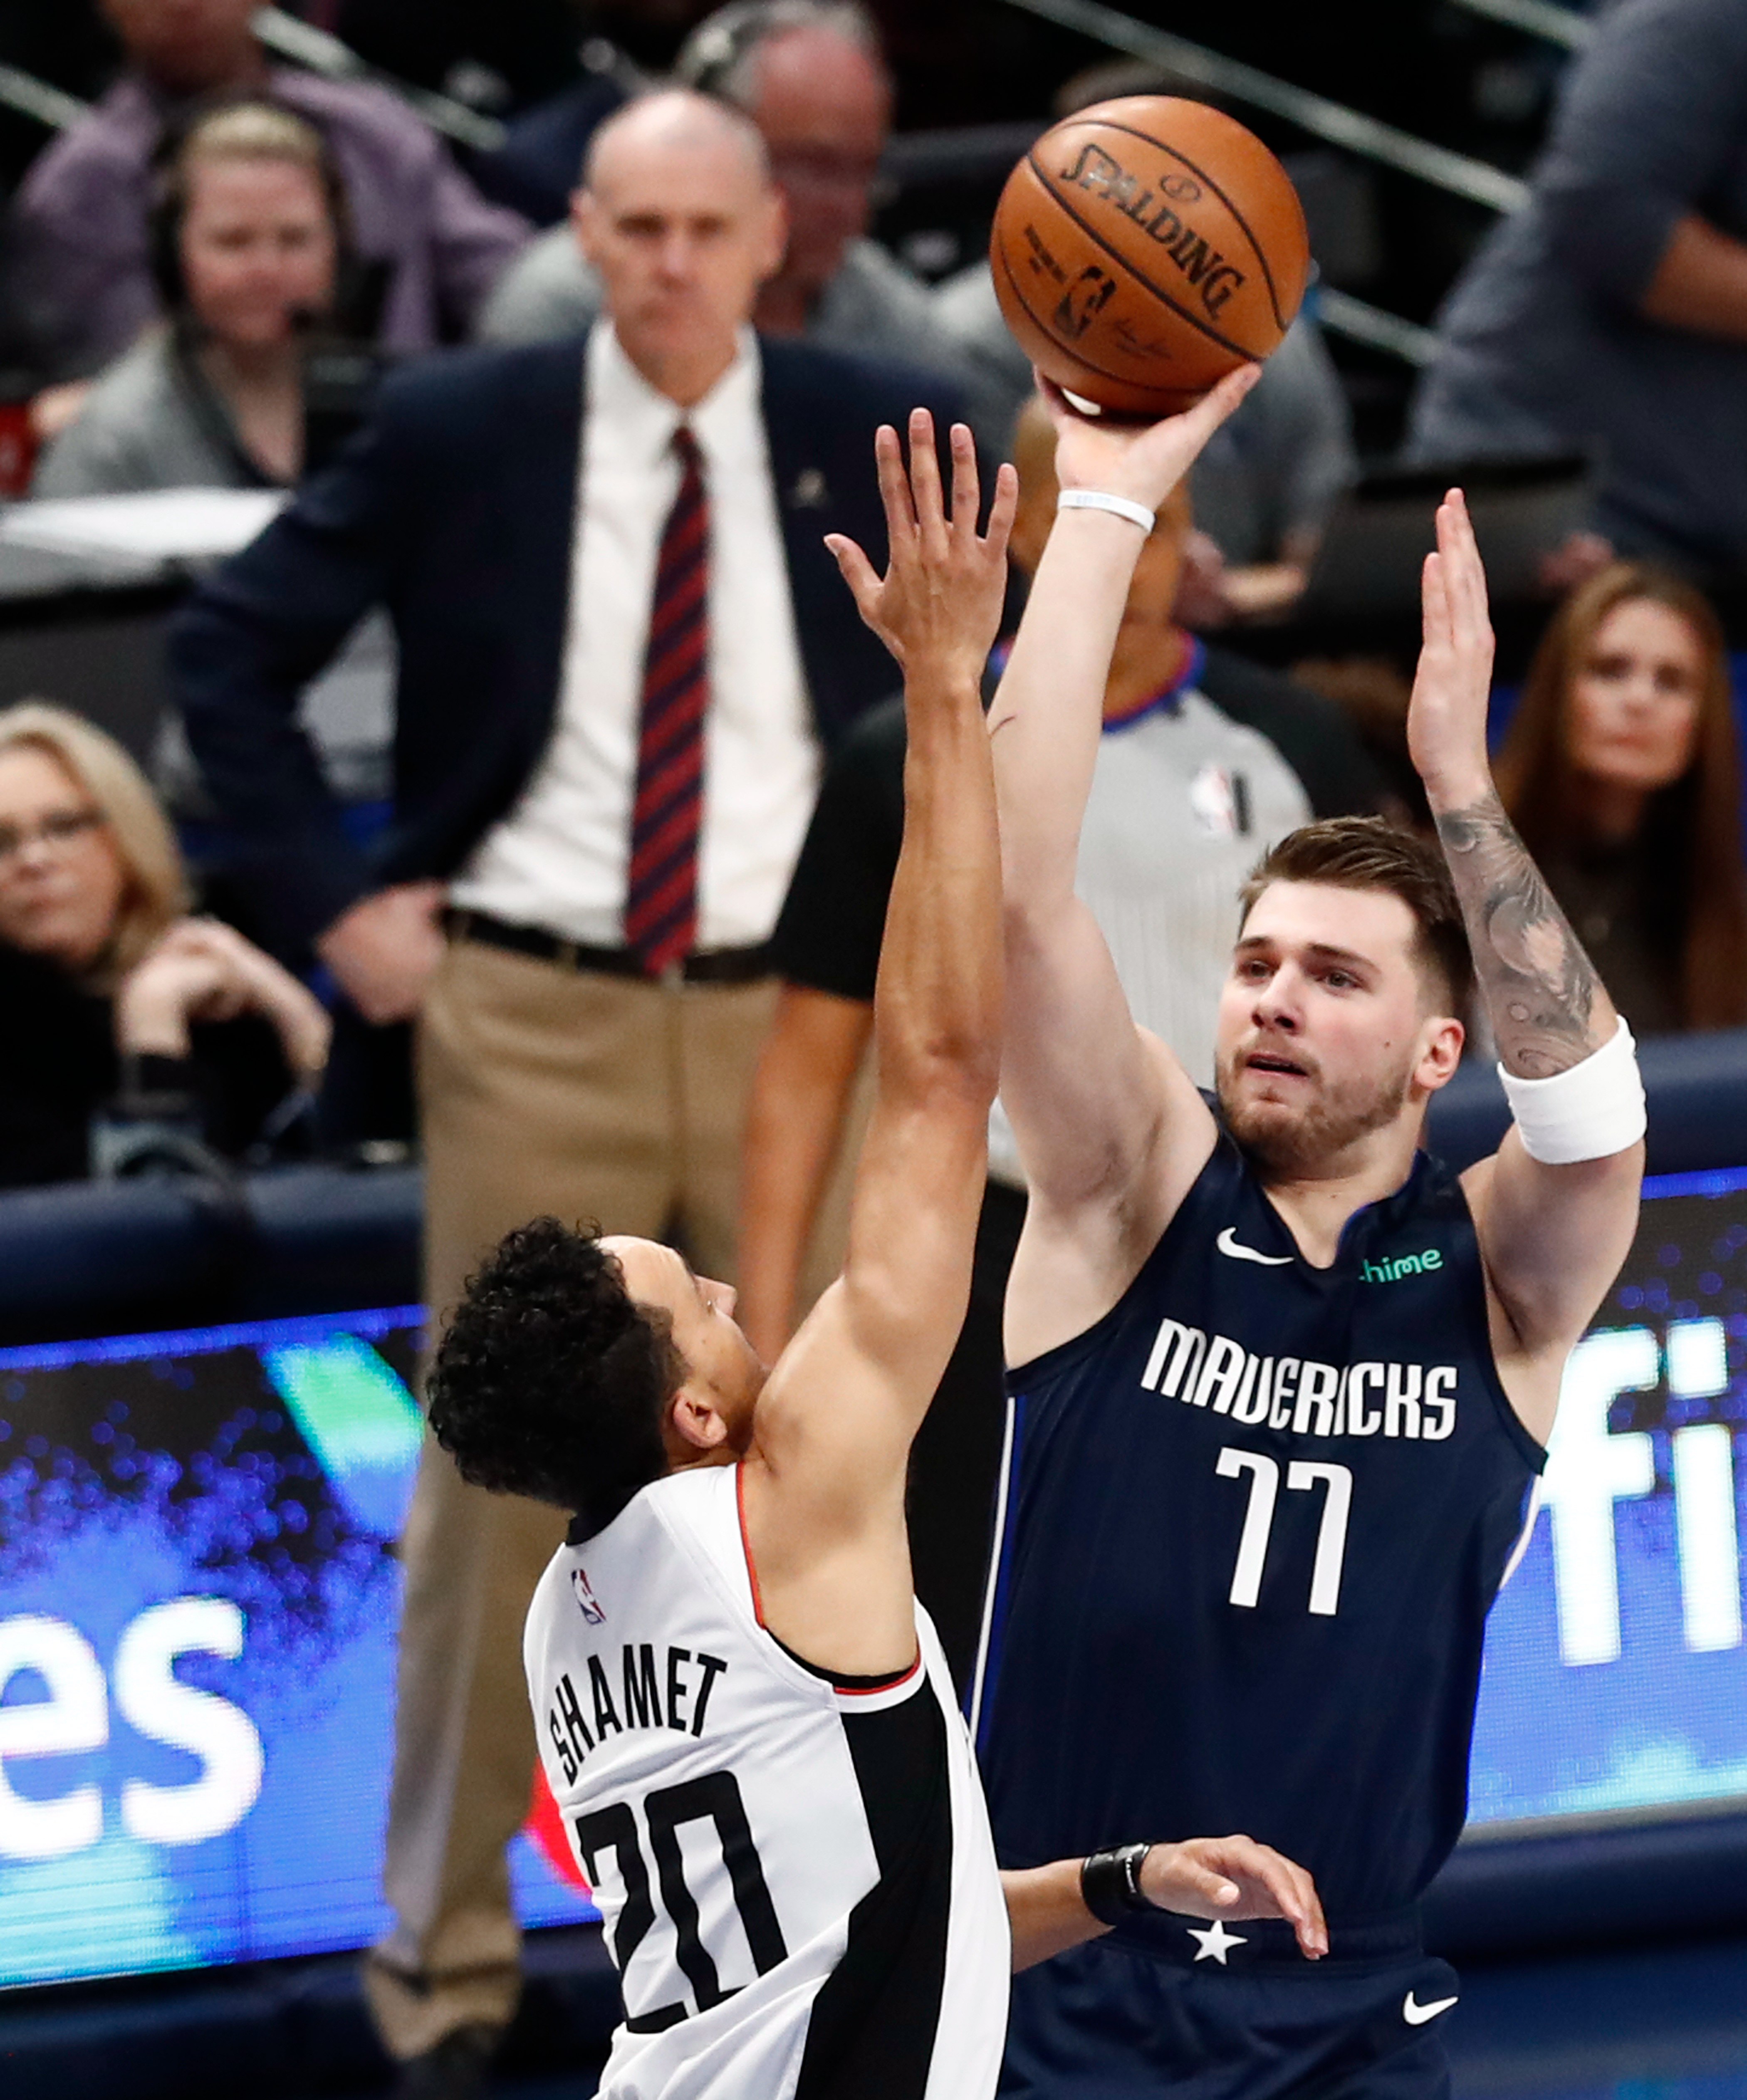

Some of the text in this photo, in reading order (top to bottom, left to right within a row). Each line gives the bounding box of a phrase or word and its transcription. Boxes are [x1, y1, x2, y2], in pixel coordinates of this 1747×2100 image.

[1061, 143, 1245, 319] SPALDING
[1359, 1249, 1443, 1283] hime
[1141, 1318, 1457, 1440] MAVERICKS
[1216, 1447, 1353, 1615] 77
[0, 1595, 265, 1860] es
[550, 1644, 727, 1787] SHAMET
[576, 1770, 787, 2034] 20
